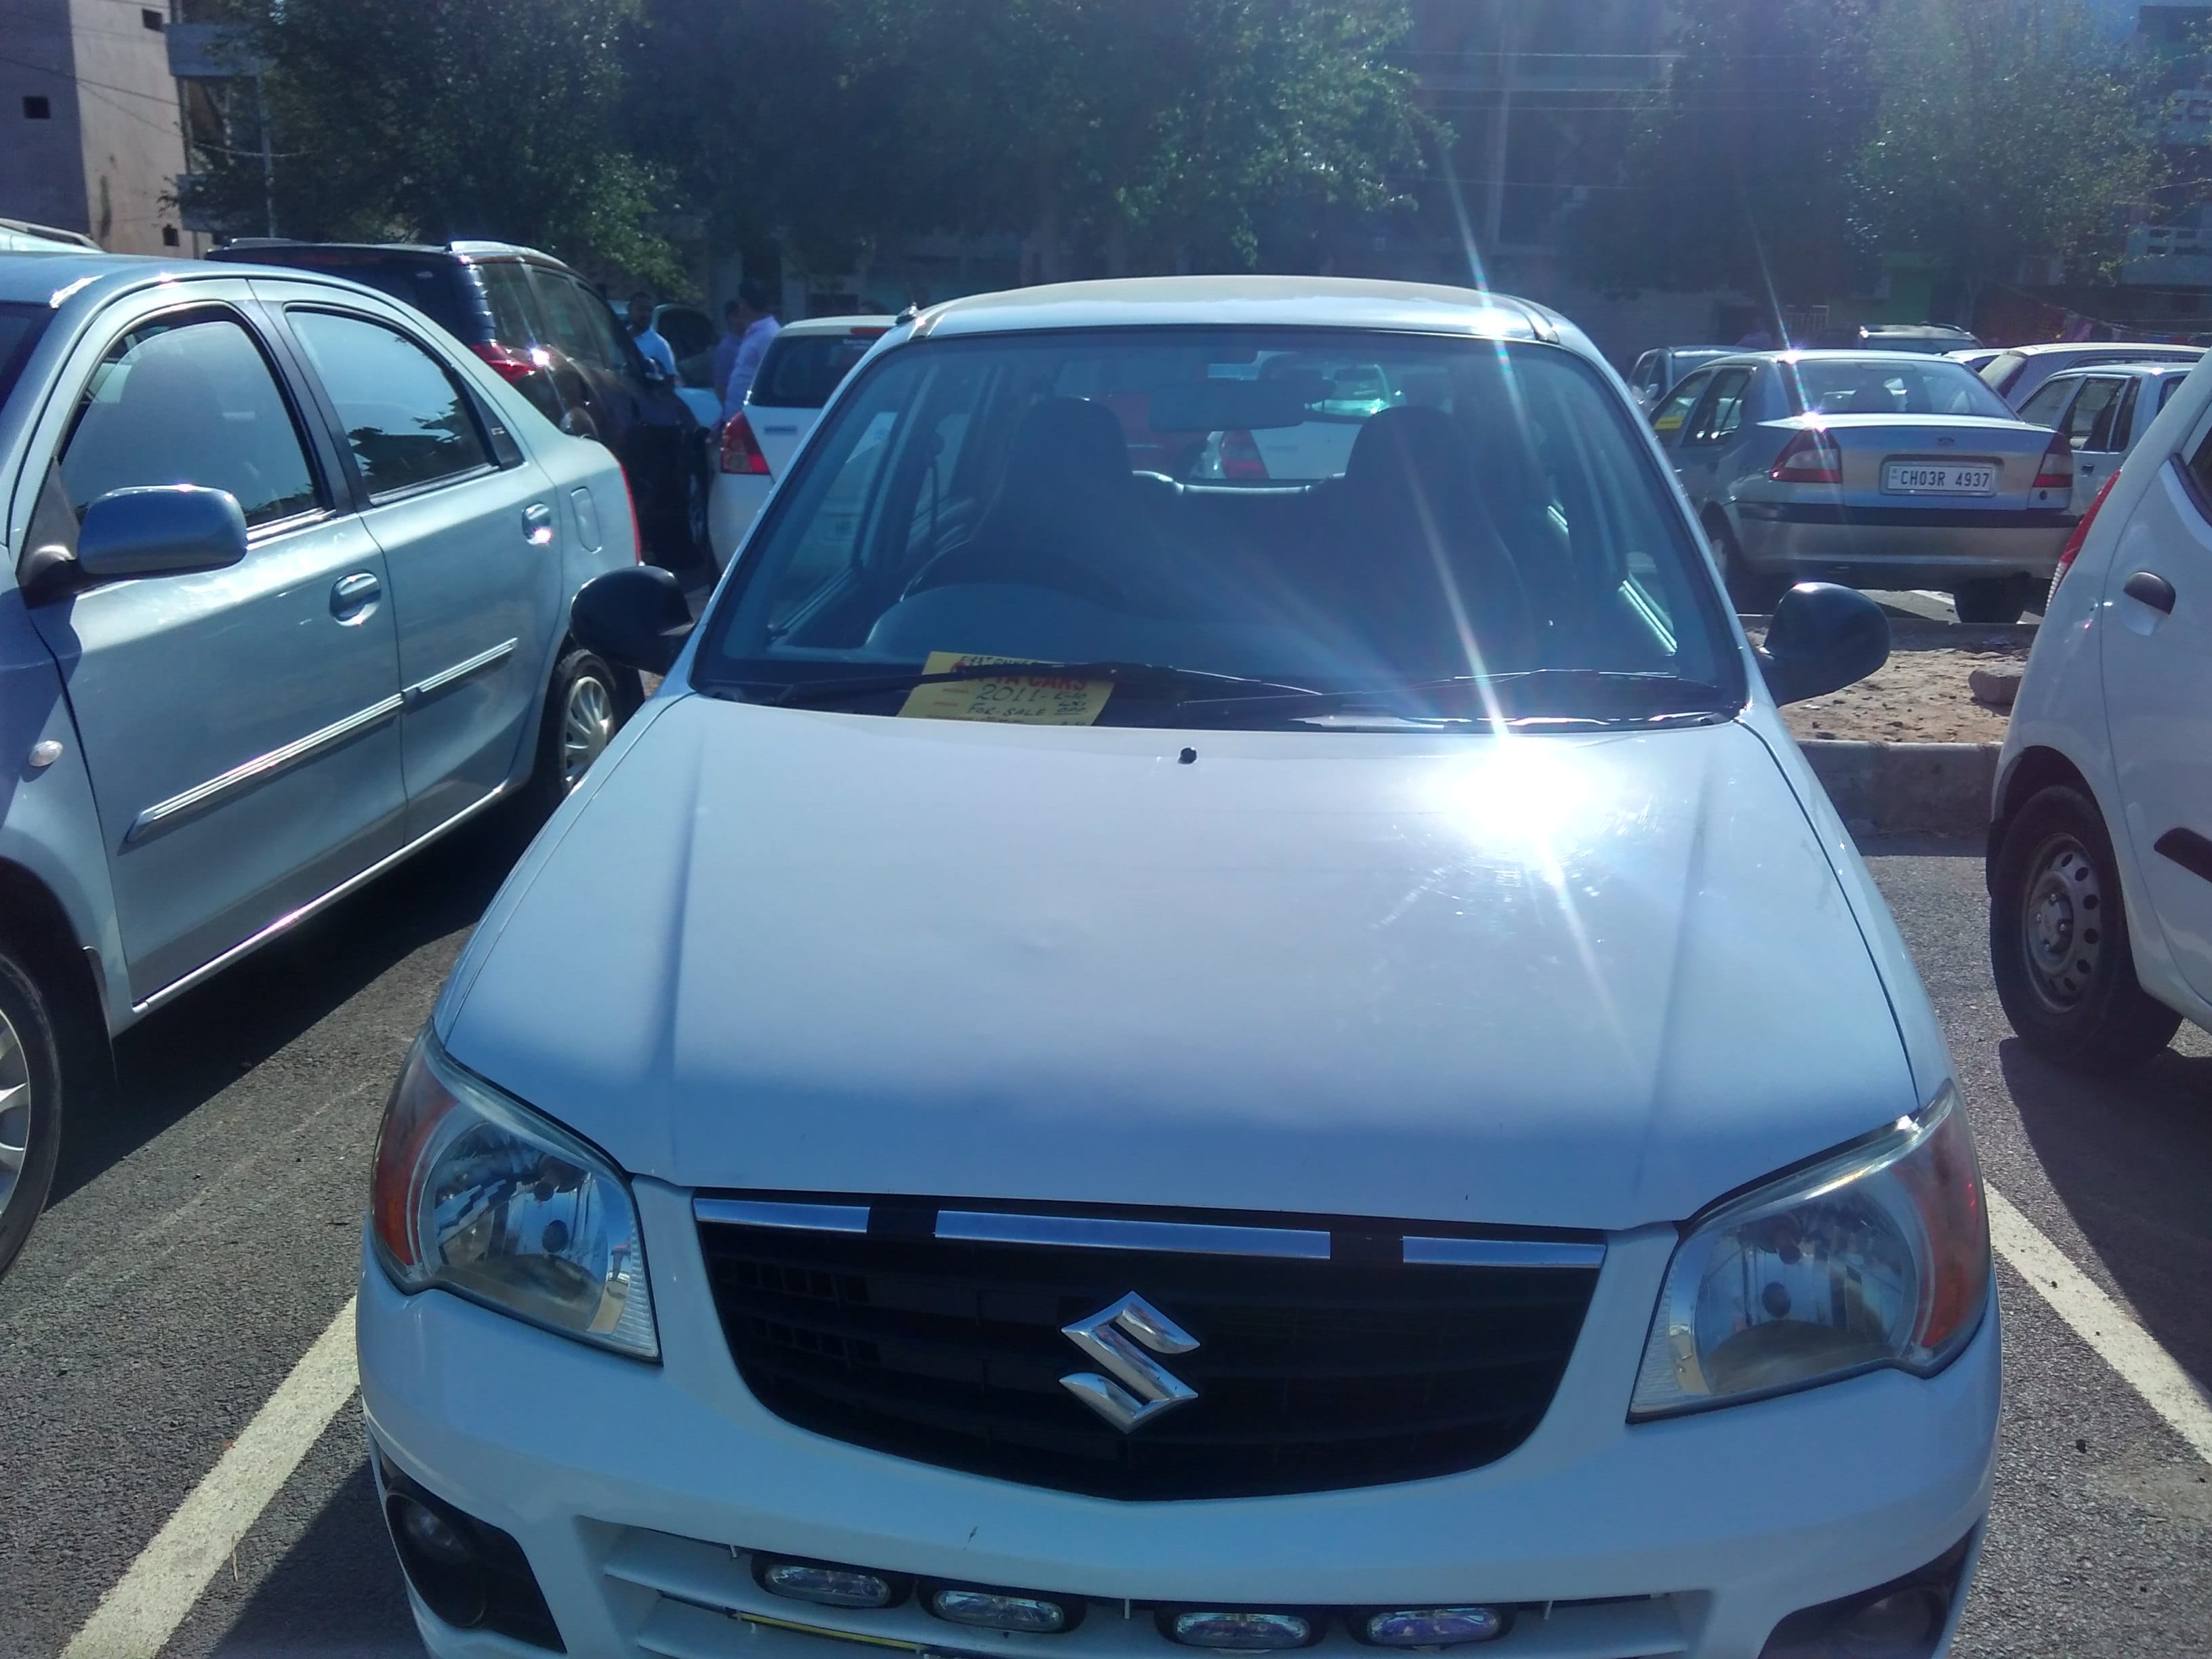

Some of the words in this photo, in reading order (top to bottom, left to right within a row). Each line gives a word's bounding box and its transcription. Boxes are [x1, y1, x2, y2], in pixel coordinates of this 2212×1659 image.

[1900, 470, 1946, 487] CH03R
[1954, 472, 1990, 488] 4937
[1002, 708, 1047, 717] SALE
